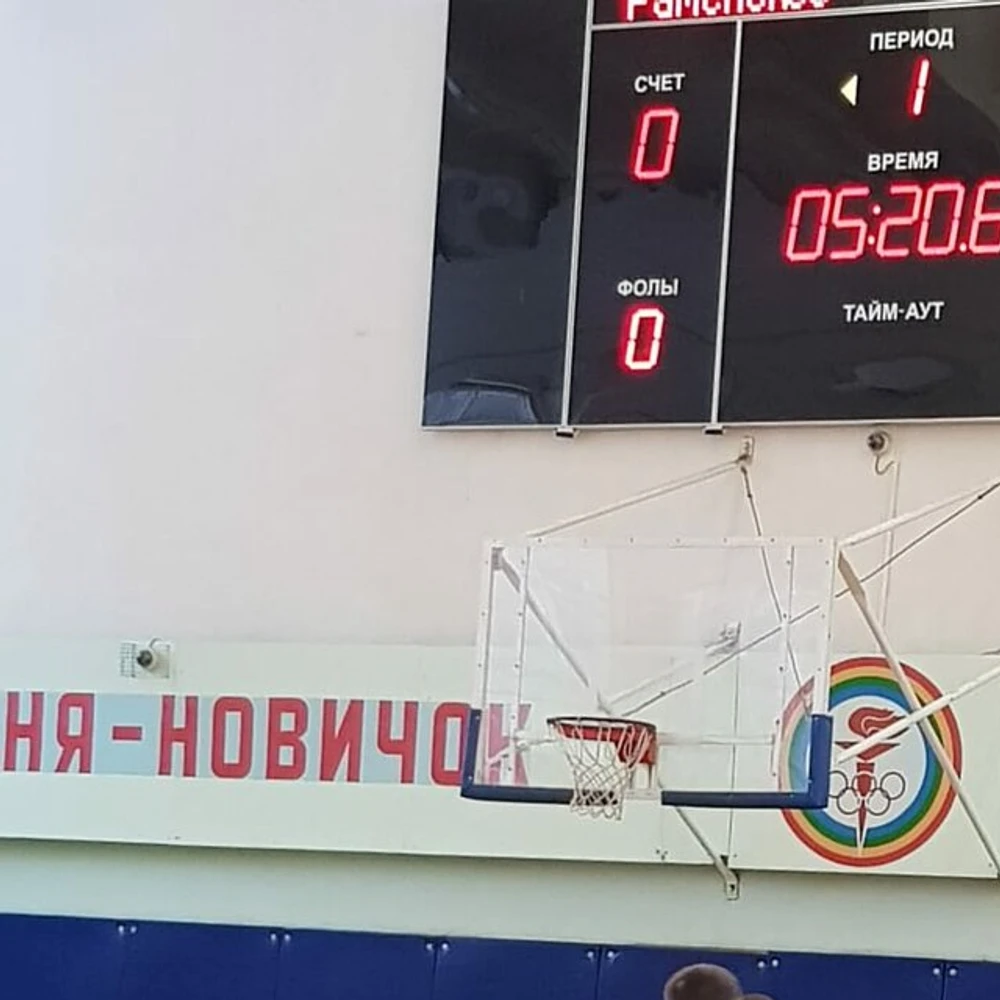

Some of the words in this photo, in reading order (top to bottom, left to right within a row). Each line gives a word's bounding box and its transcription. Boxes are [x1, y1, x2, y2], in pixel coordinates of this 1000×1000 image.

[869, 28, 954, 51] ПЕРИОД
[634, 72, 686, 94] СЧЕТ
[912, 58, 930, 116] 1
[633, 107, 680, 180] 0
[867, 150, 939, 172] ВРЕМЯ
[616, 278, 679, 297] ФОЛЫ
[843, 300, 945, 323] ТАЙМ-АУТ
[623, 307, 665, 371] 0
